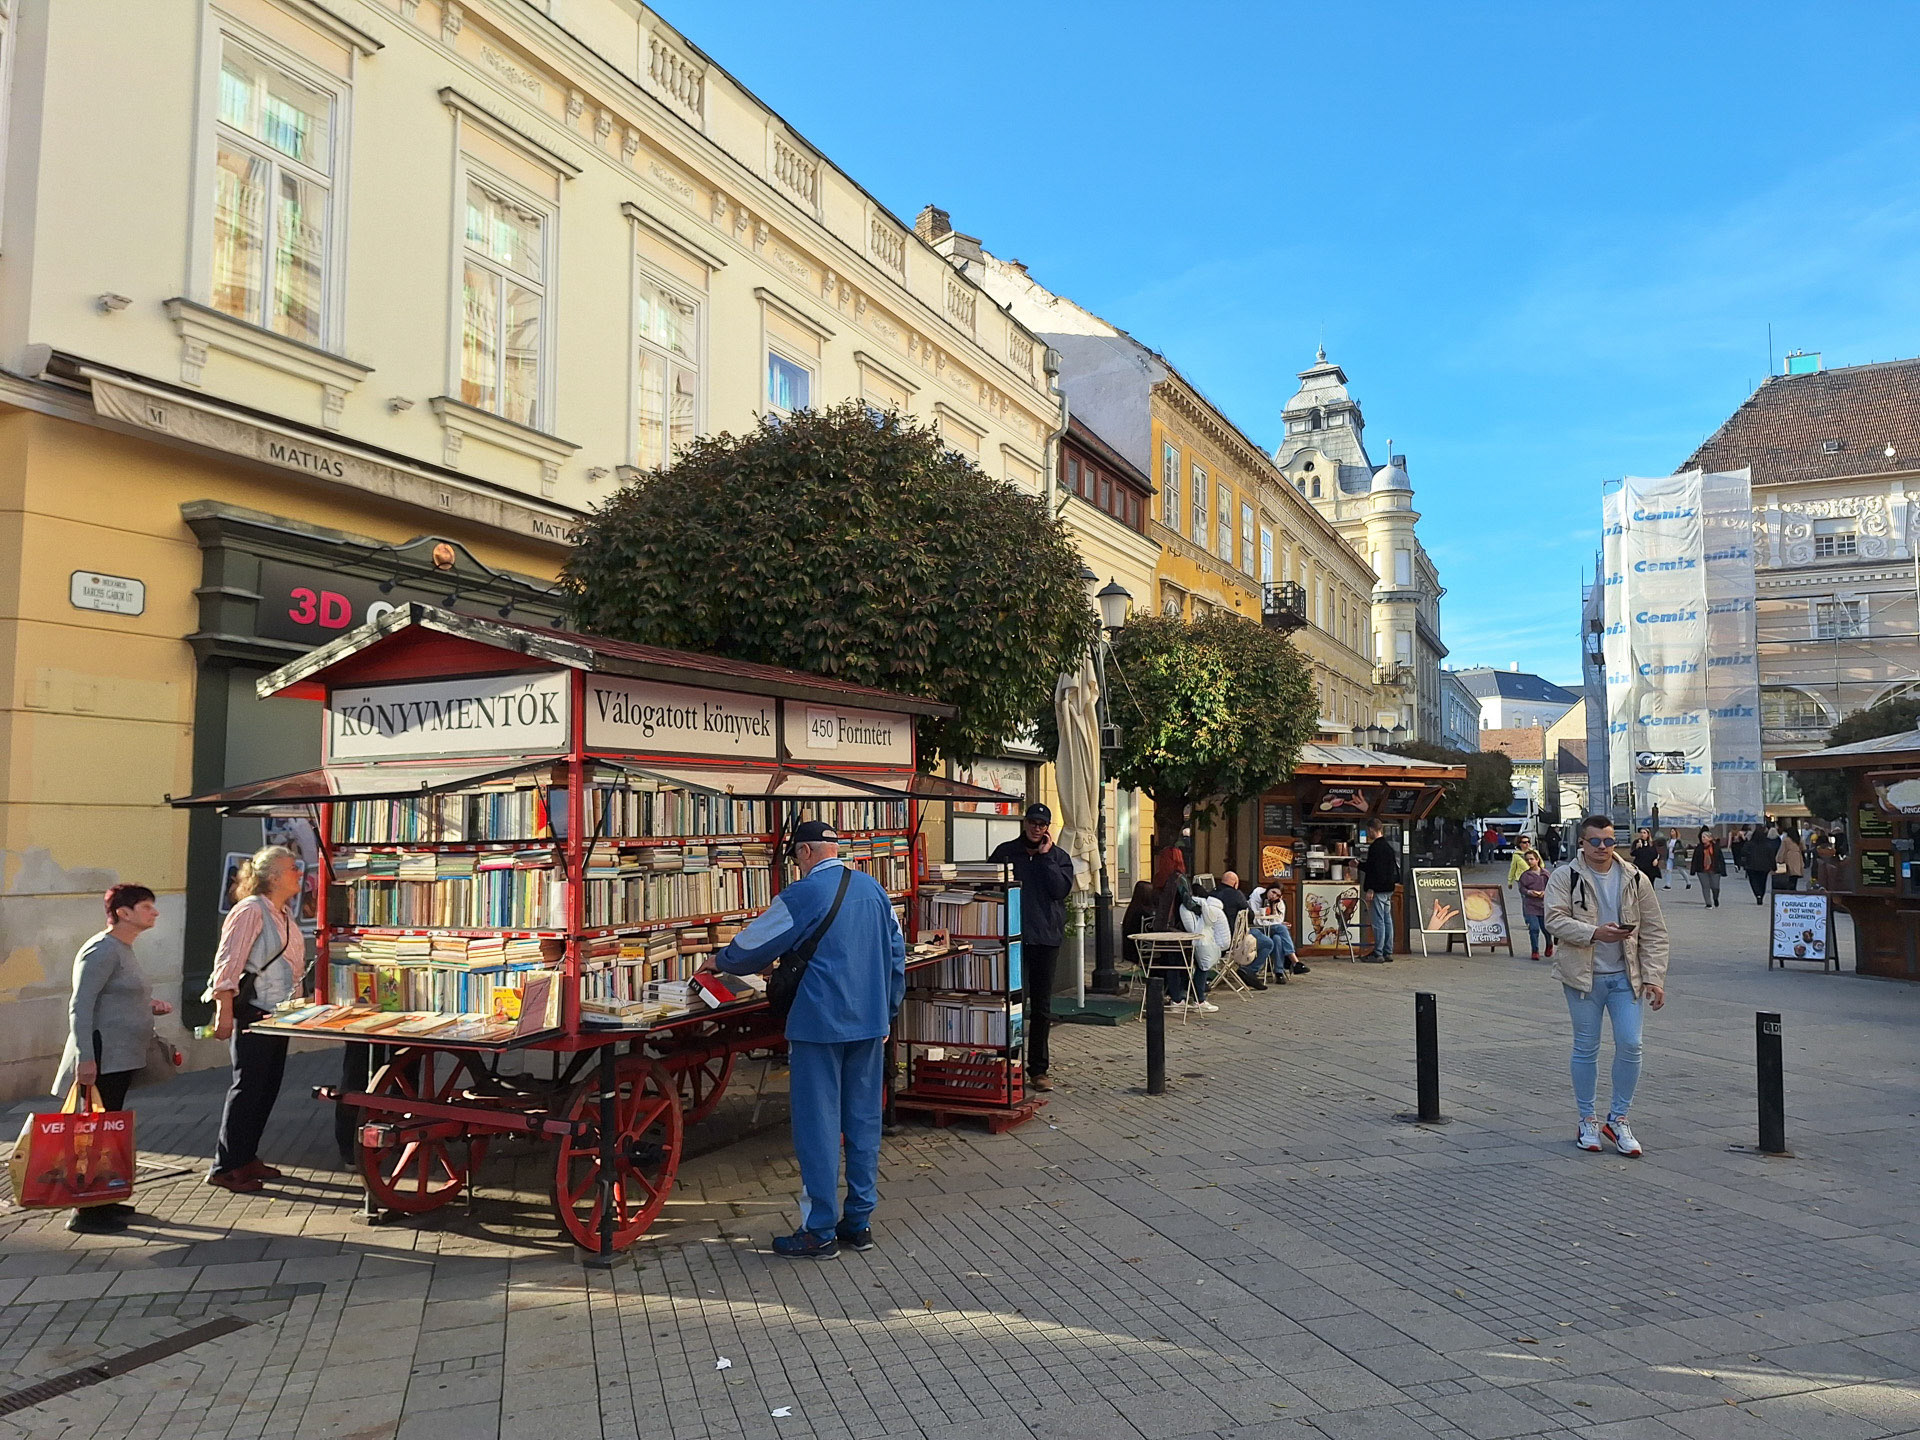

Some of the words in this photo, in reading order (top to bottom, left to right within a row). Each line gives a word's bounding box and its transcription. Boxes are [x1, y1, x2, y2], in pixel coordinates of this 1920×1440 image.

[150, 408, 162, 424] M
[270, 443, 343, 477] MATIAS
[440, 494, 449, 507] M
[1633, 506, 1694, 521] Cemix
[533, 520, 571, 541] MATI
[1703, 547, 1748, 562] emix
[1634, 557, 1696, 573] Cemix
[288, 588, 353, 629] 3D
[1636, 608, 1697, 624] Cemix
[1708, 652, 1753, 667] emix
[1638, 660, 1699, 676] Cemix
[340, 684, 560, 737] KÖNYVMENTŐK
[594, 689, 698, 738] Válogatott
[702, 702, 771, 744] könyvek
[1638, 712, 1700, 727] Cemix
[811, 719, 833, 738] 450
[837, 717, 892, 746] Forintért
[1418, 878, 1457, 887] CHURROS
